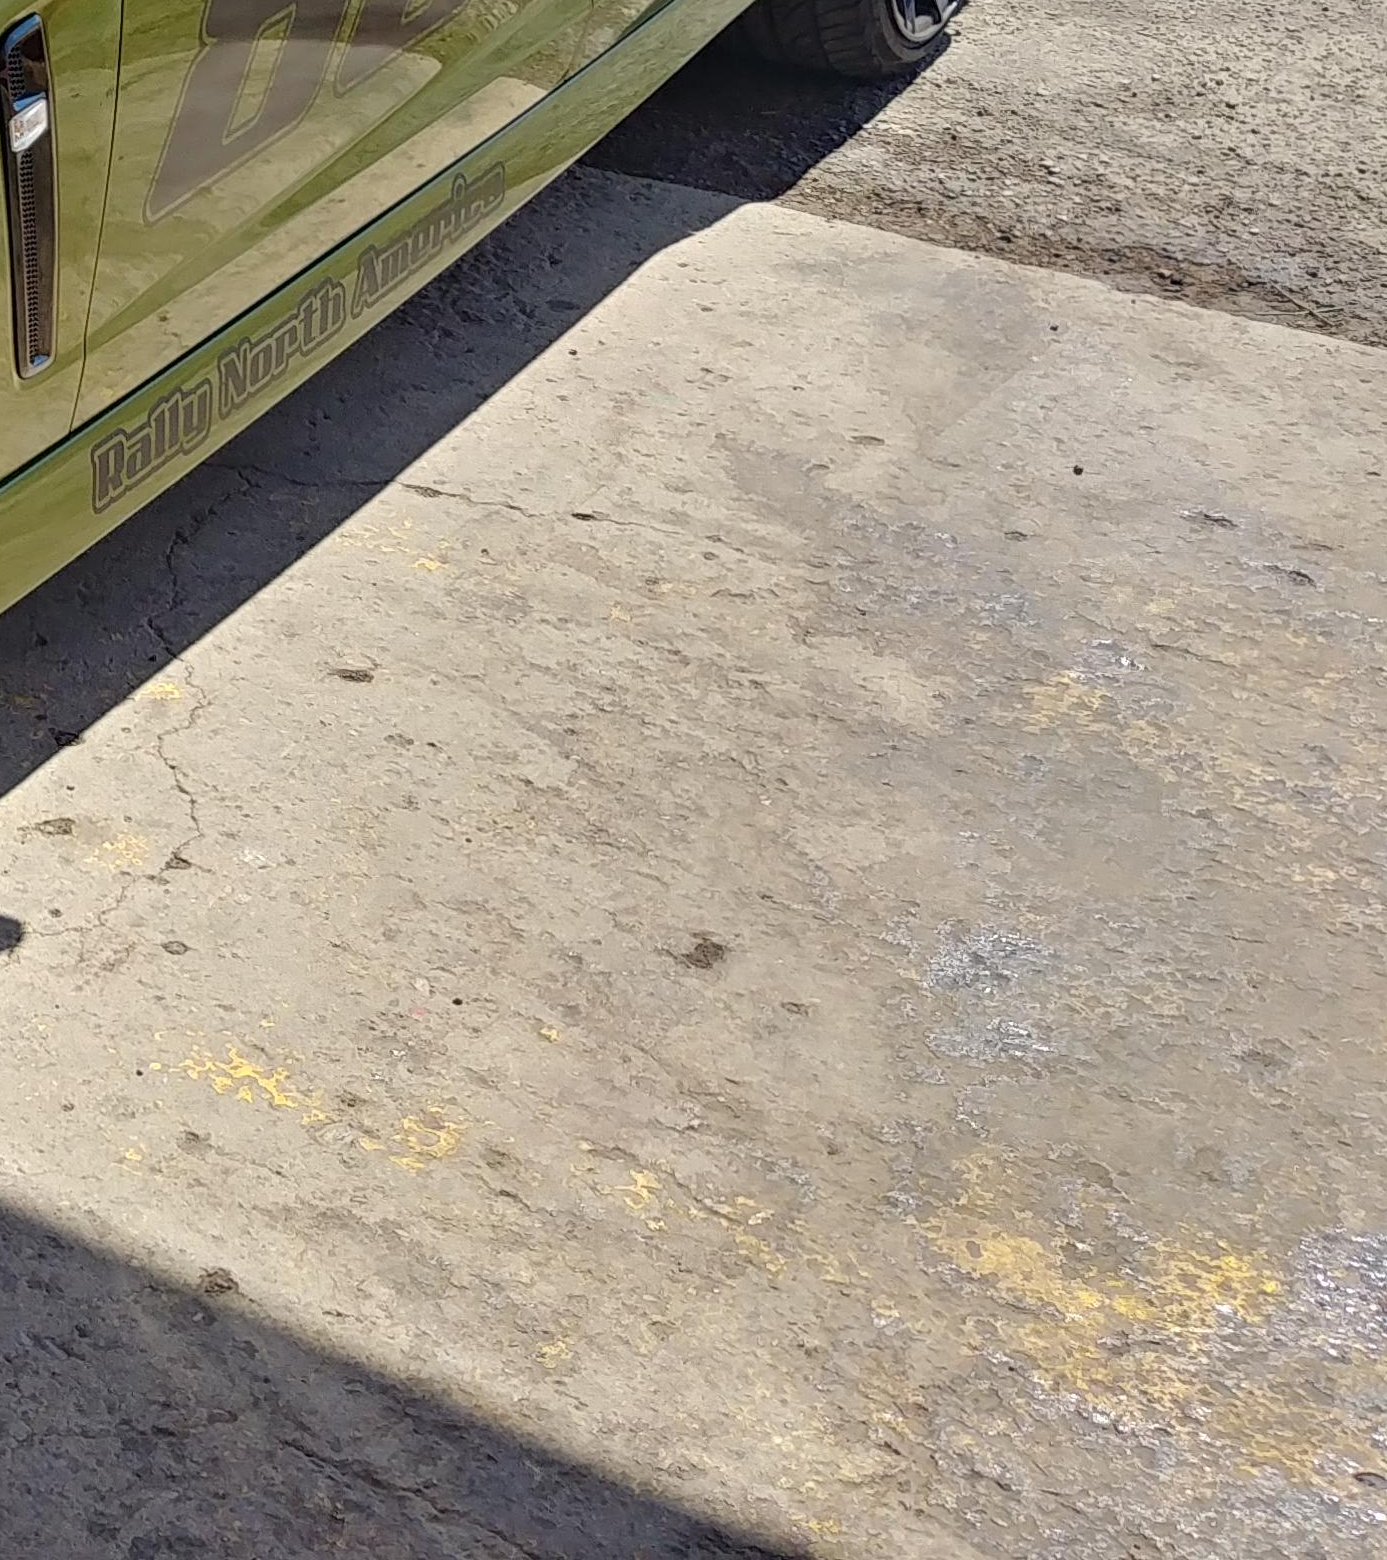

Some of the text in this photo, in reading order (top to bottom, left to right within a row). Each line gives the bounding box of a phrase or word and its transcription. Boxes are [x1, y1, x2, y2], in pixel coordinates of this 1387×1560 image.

[91, 160, 506, 515] Rally North America
